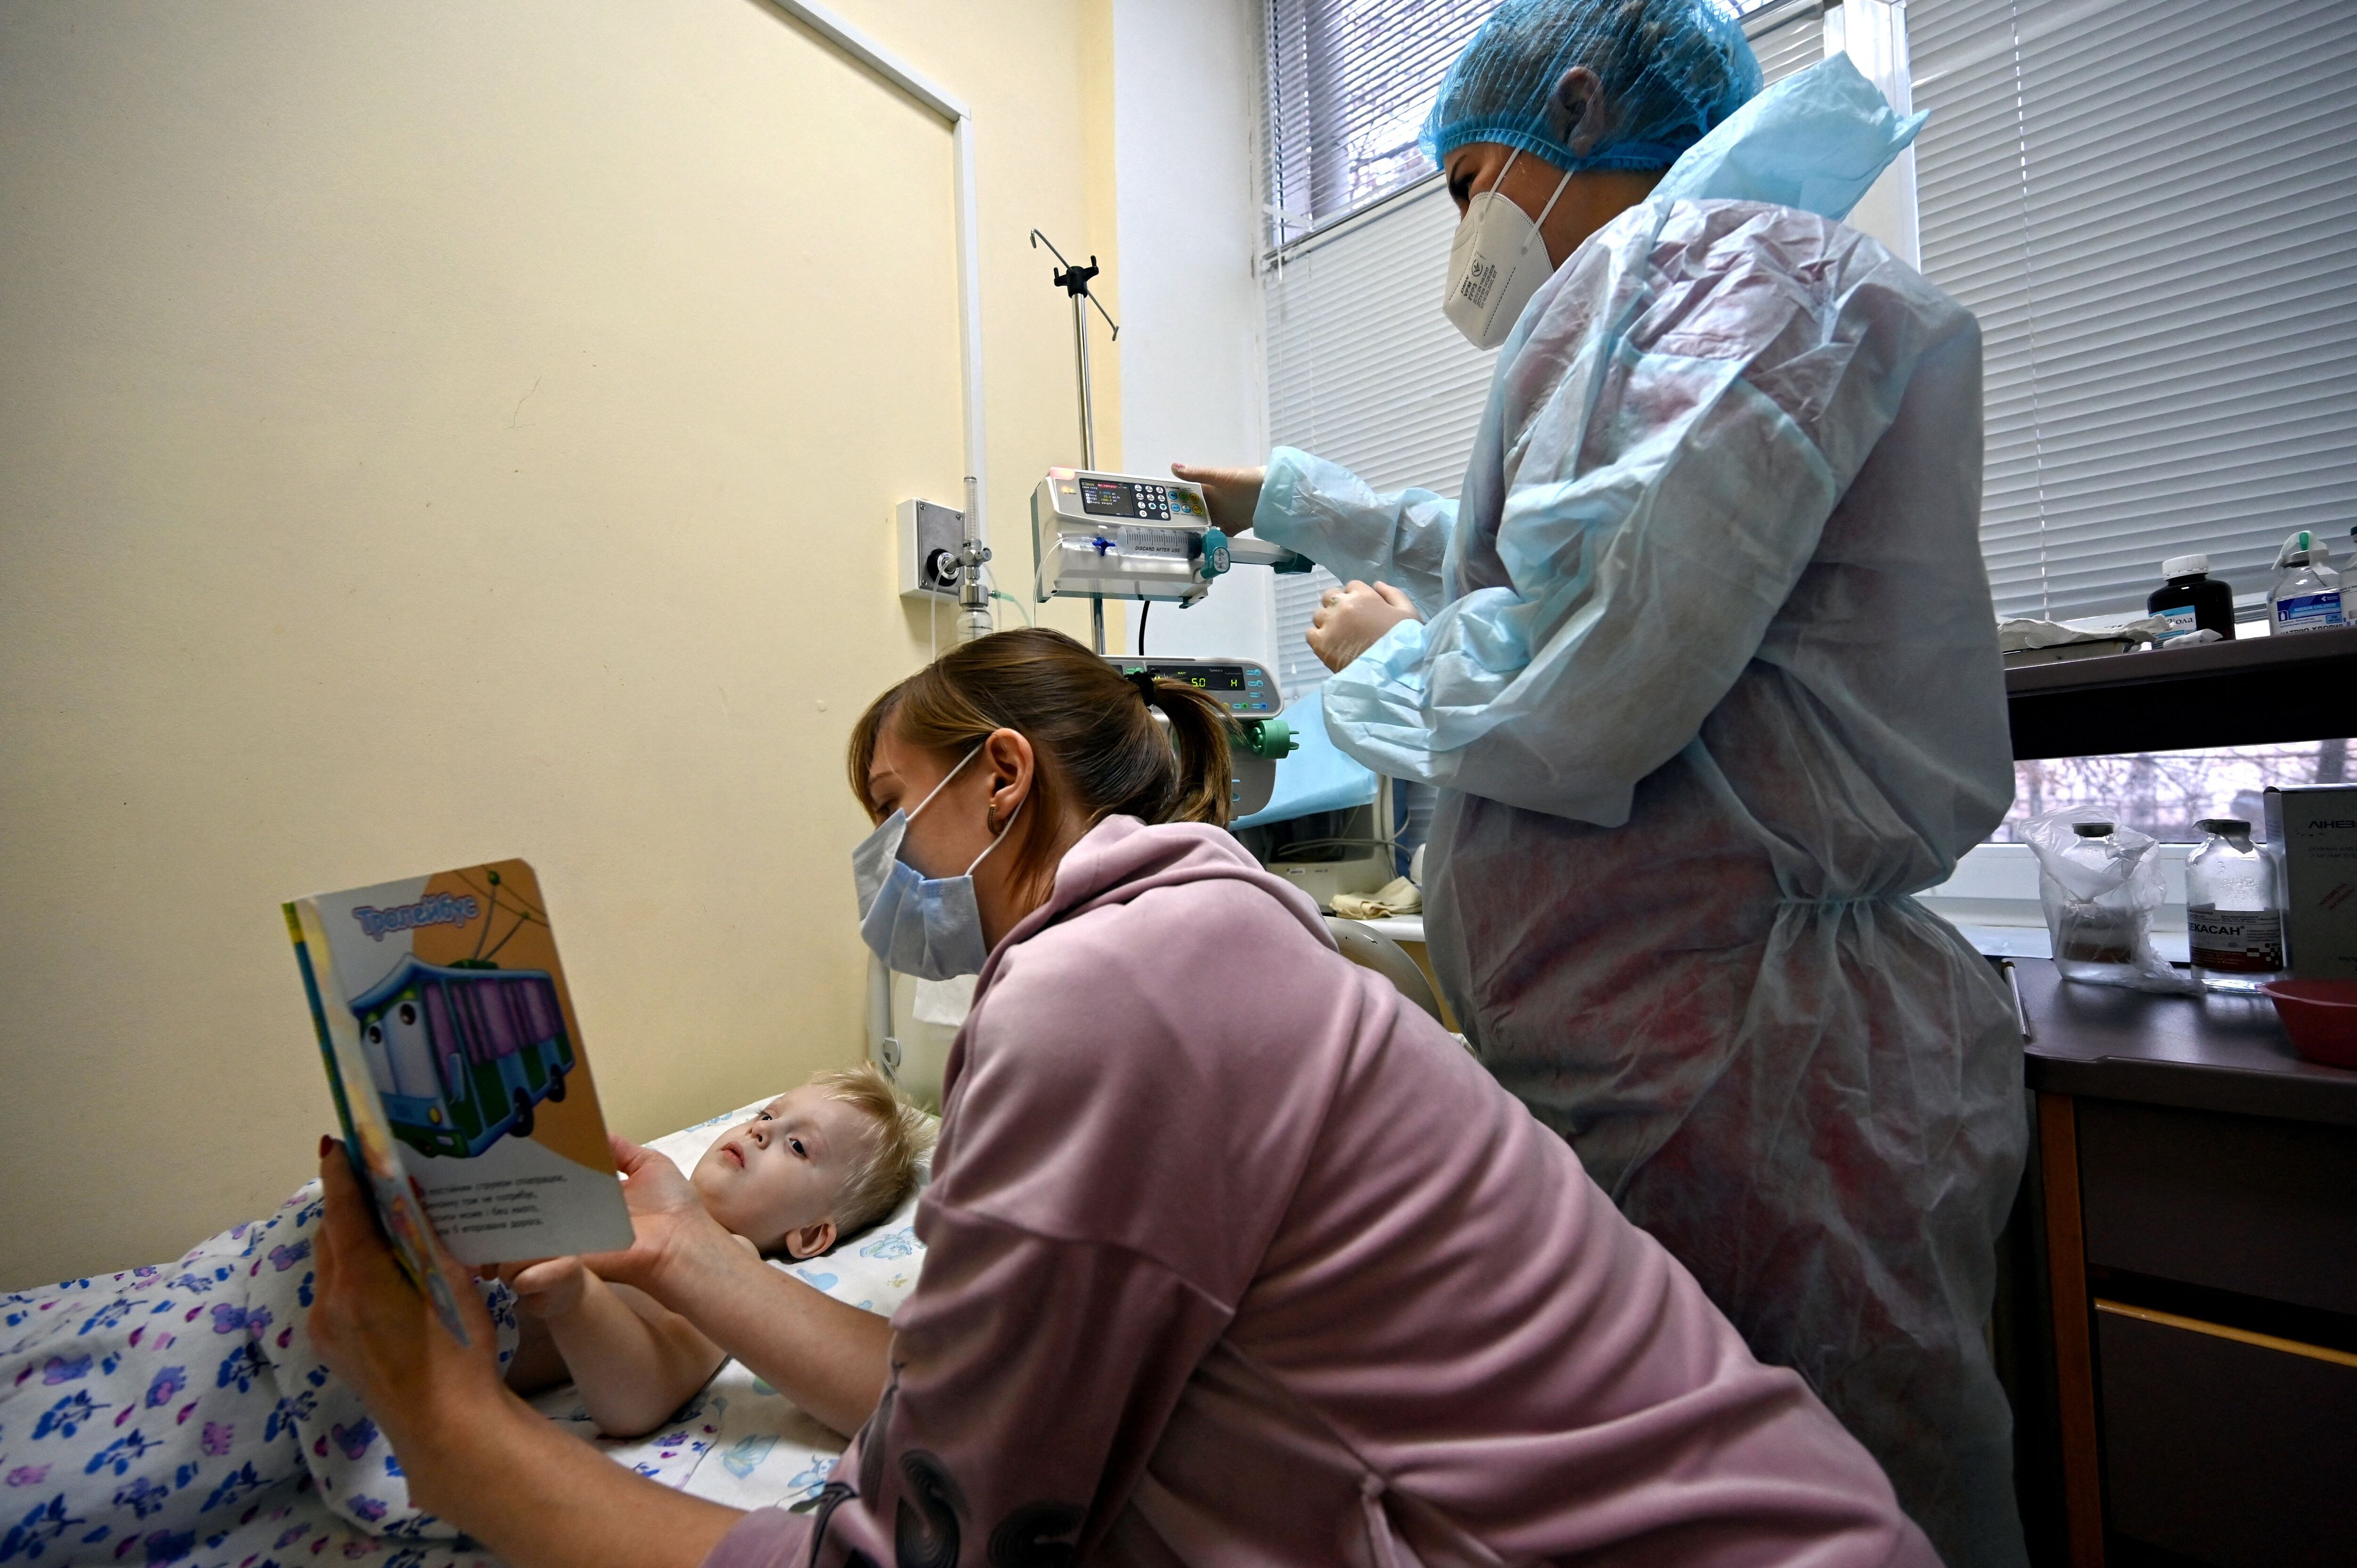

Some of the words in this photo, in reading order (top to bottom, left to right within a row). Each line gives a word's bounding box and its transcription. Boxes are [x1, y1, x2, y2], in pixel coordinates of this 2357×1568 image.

[1463, 281, 1472, 296] VPM
[1468, 283, 1477, 301] FFP3
[1191, 678, 1205, 687] 5.0
[2308, 820, 2357, 829] ЛІНЕЗ
[352, 891, 480, 942] Тролейбус
